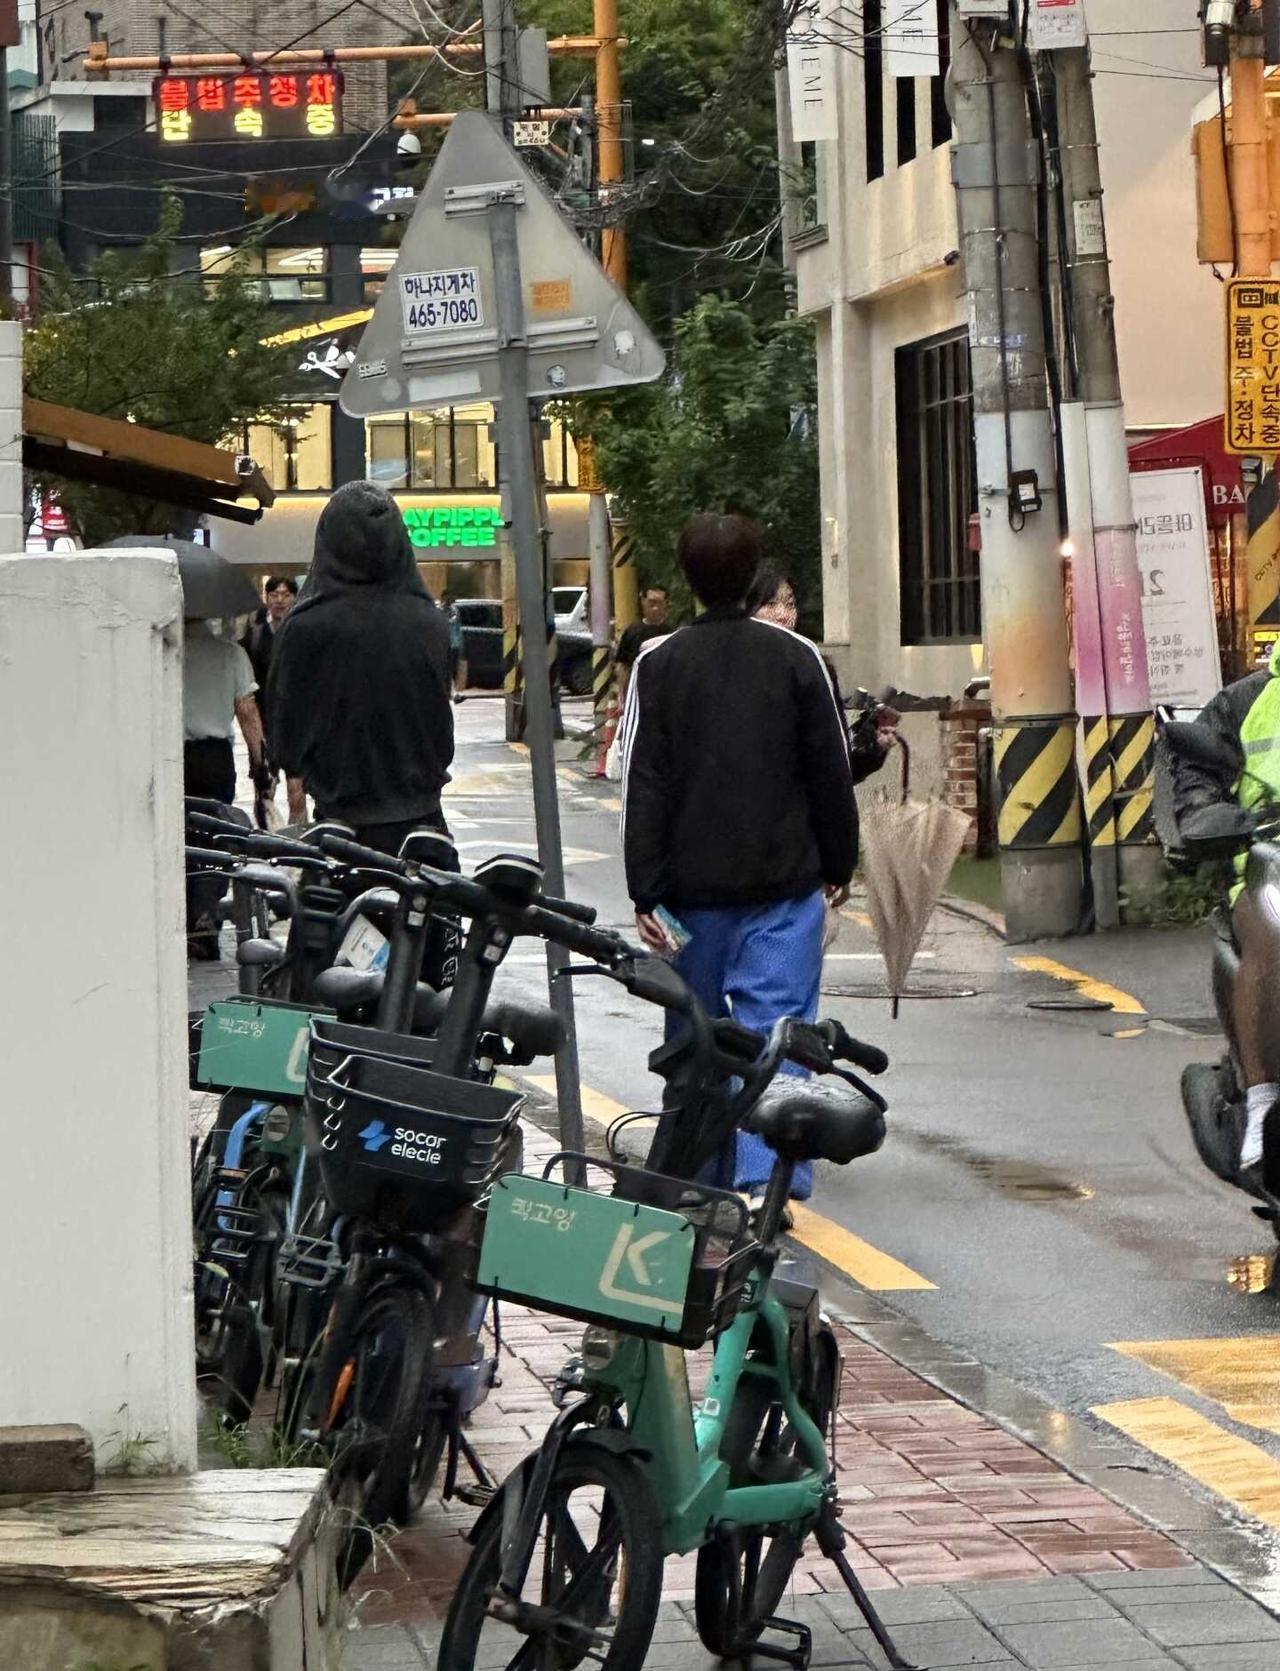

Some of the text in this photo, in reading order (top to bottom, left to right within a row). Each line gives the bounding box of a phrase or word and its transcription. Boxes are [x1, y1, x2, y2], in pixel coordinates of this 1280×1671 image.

[160, 74, 335, 112] 불법주정차
[408, 298, 479, 329] 465-7080
[1233, 315, 1254, 359] 불법
[408, 527, 497, 547] OFFEE
[394, 1127, 448, 1149] socar
[391, 1142, 442, 1165] elecle
